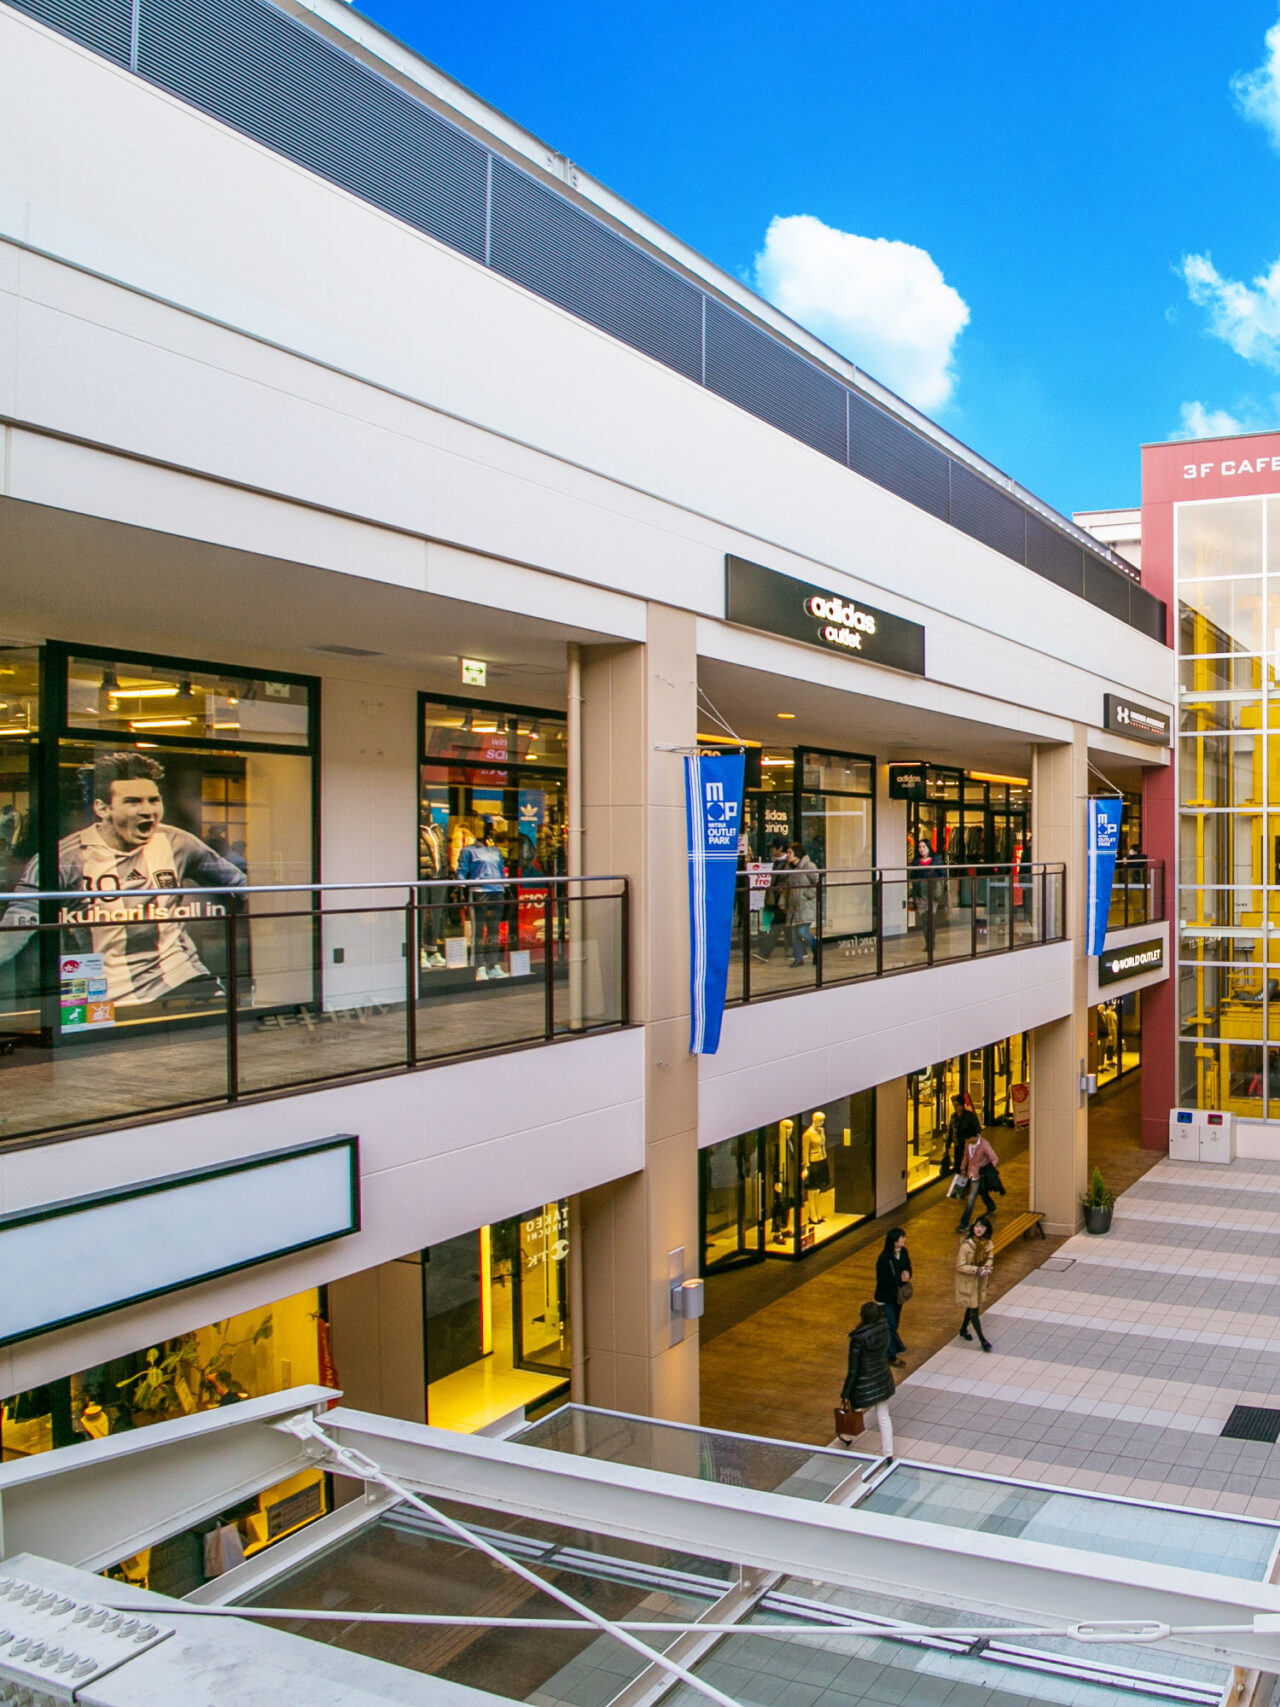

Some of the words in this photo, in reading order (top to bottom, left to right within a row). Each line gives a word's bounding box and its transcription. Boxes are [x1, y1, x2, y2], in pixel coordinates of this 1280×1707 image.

[1183, 463, 1214, 479] 3F
[810, 595, 876, 635] adidas
[824, 625, 863, 650] outlet
[707, 828, 737, 837] OUTLET
[708, 836, 731, 845] PARK
[149, 902, 175, 920] is
[175, 901, 201, 918] all
[206, 901, 226, 916] in
[1140, 949, 1161, 964] OUTLET
